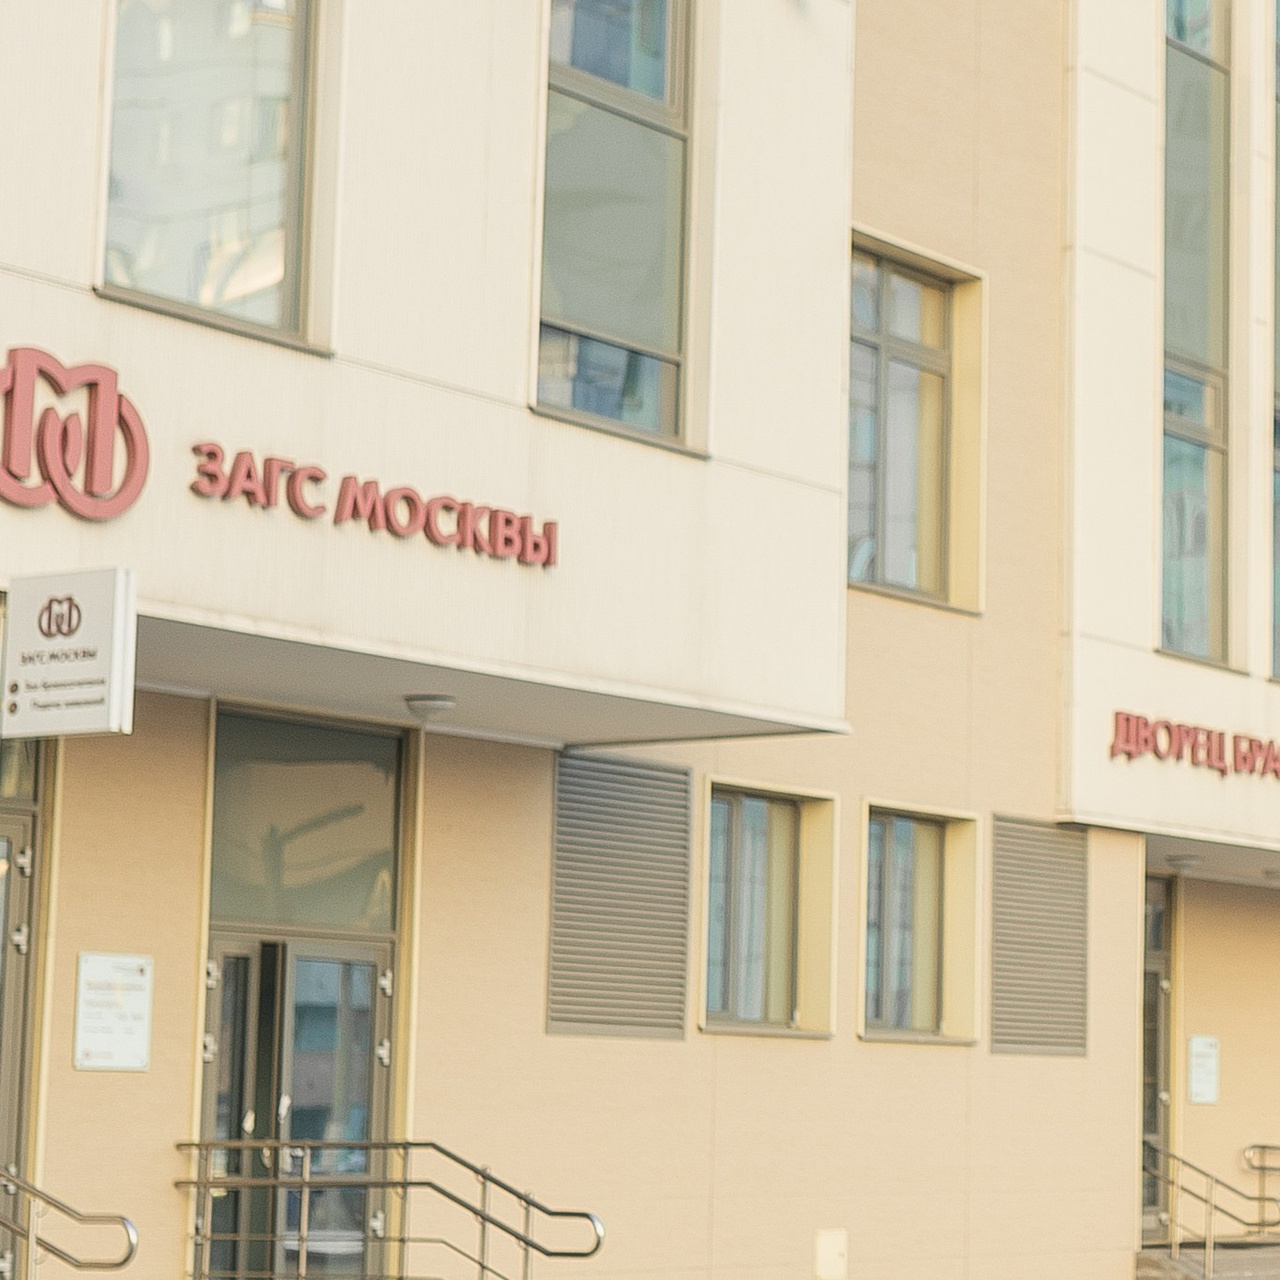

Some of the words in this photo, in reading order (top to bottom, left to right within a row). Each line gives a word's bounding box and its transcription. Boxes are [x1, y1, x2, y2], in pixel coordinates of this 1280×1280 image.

[190, 442, 327, 518] ЗАГС
[333, 476, 558, 568] МОСКВЫ
[1110, 711, 1228, 778] ДВОРЕЦ
